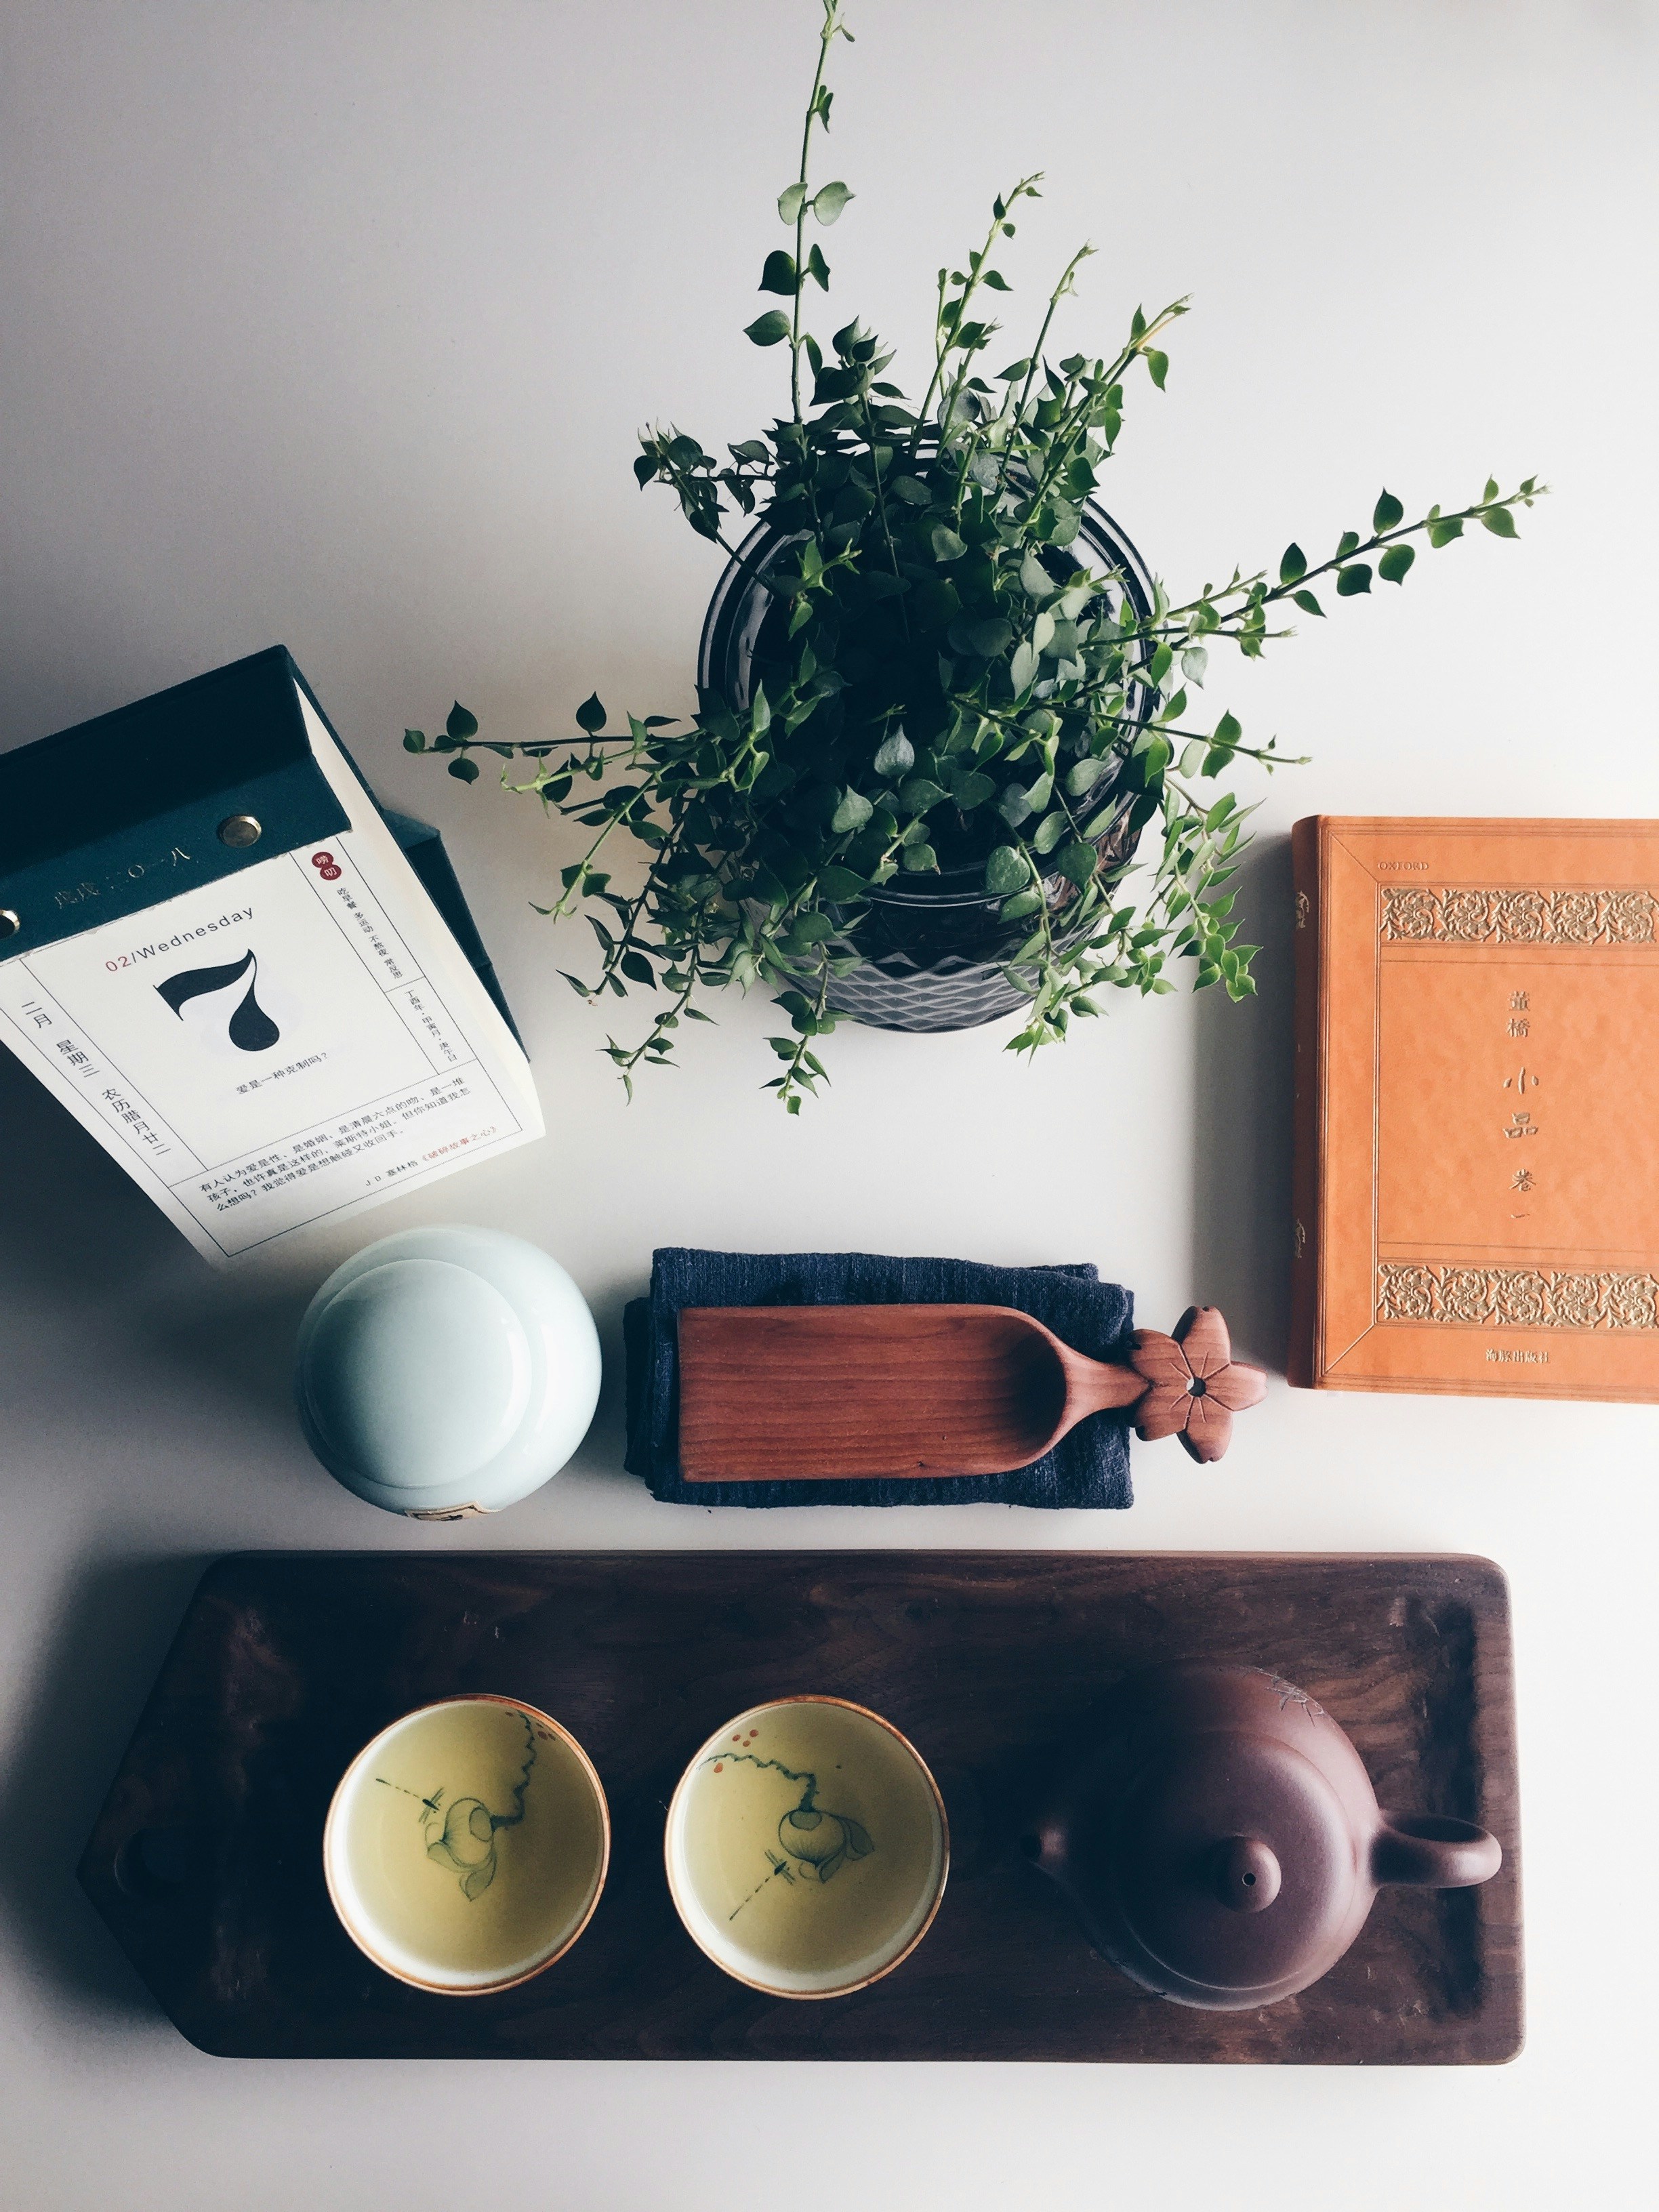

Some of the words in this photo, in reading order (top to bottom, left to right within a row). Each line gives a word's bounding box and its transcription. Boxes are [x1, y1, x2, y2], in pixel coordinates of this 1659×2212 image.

[1377, 860, 1429, 872] OXFORD
[153, 948, 280, 1052] 7
[21, 1001, 53, 1029] 二月
[56, 1039, 100, 1078] 星期三
[102, 1088, 171, 1156] 农历腊月廿二
